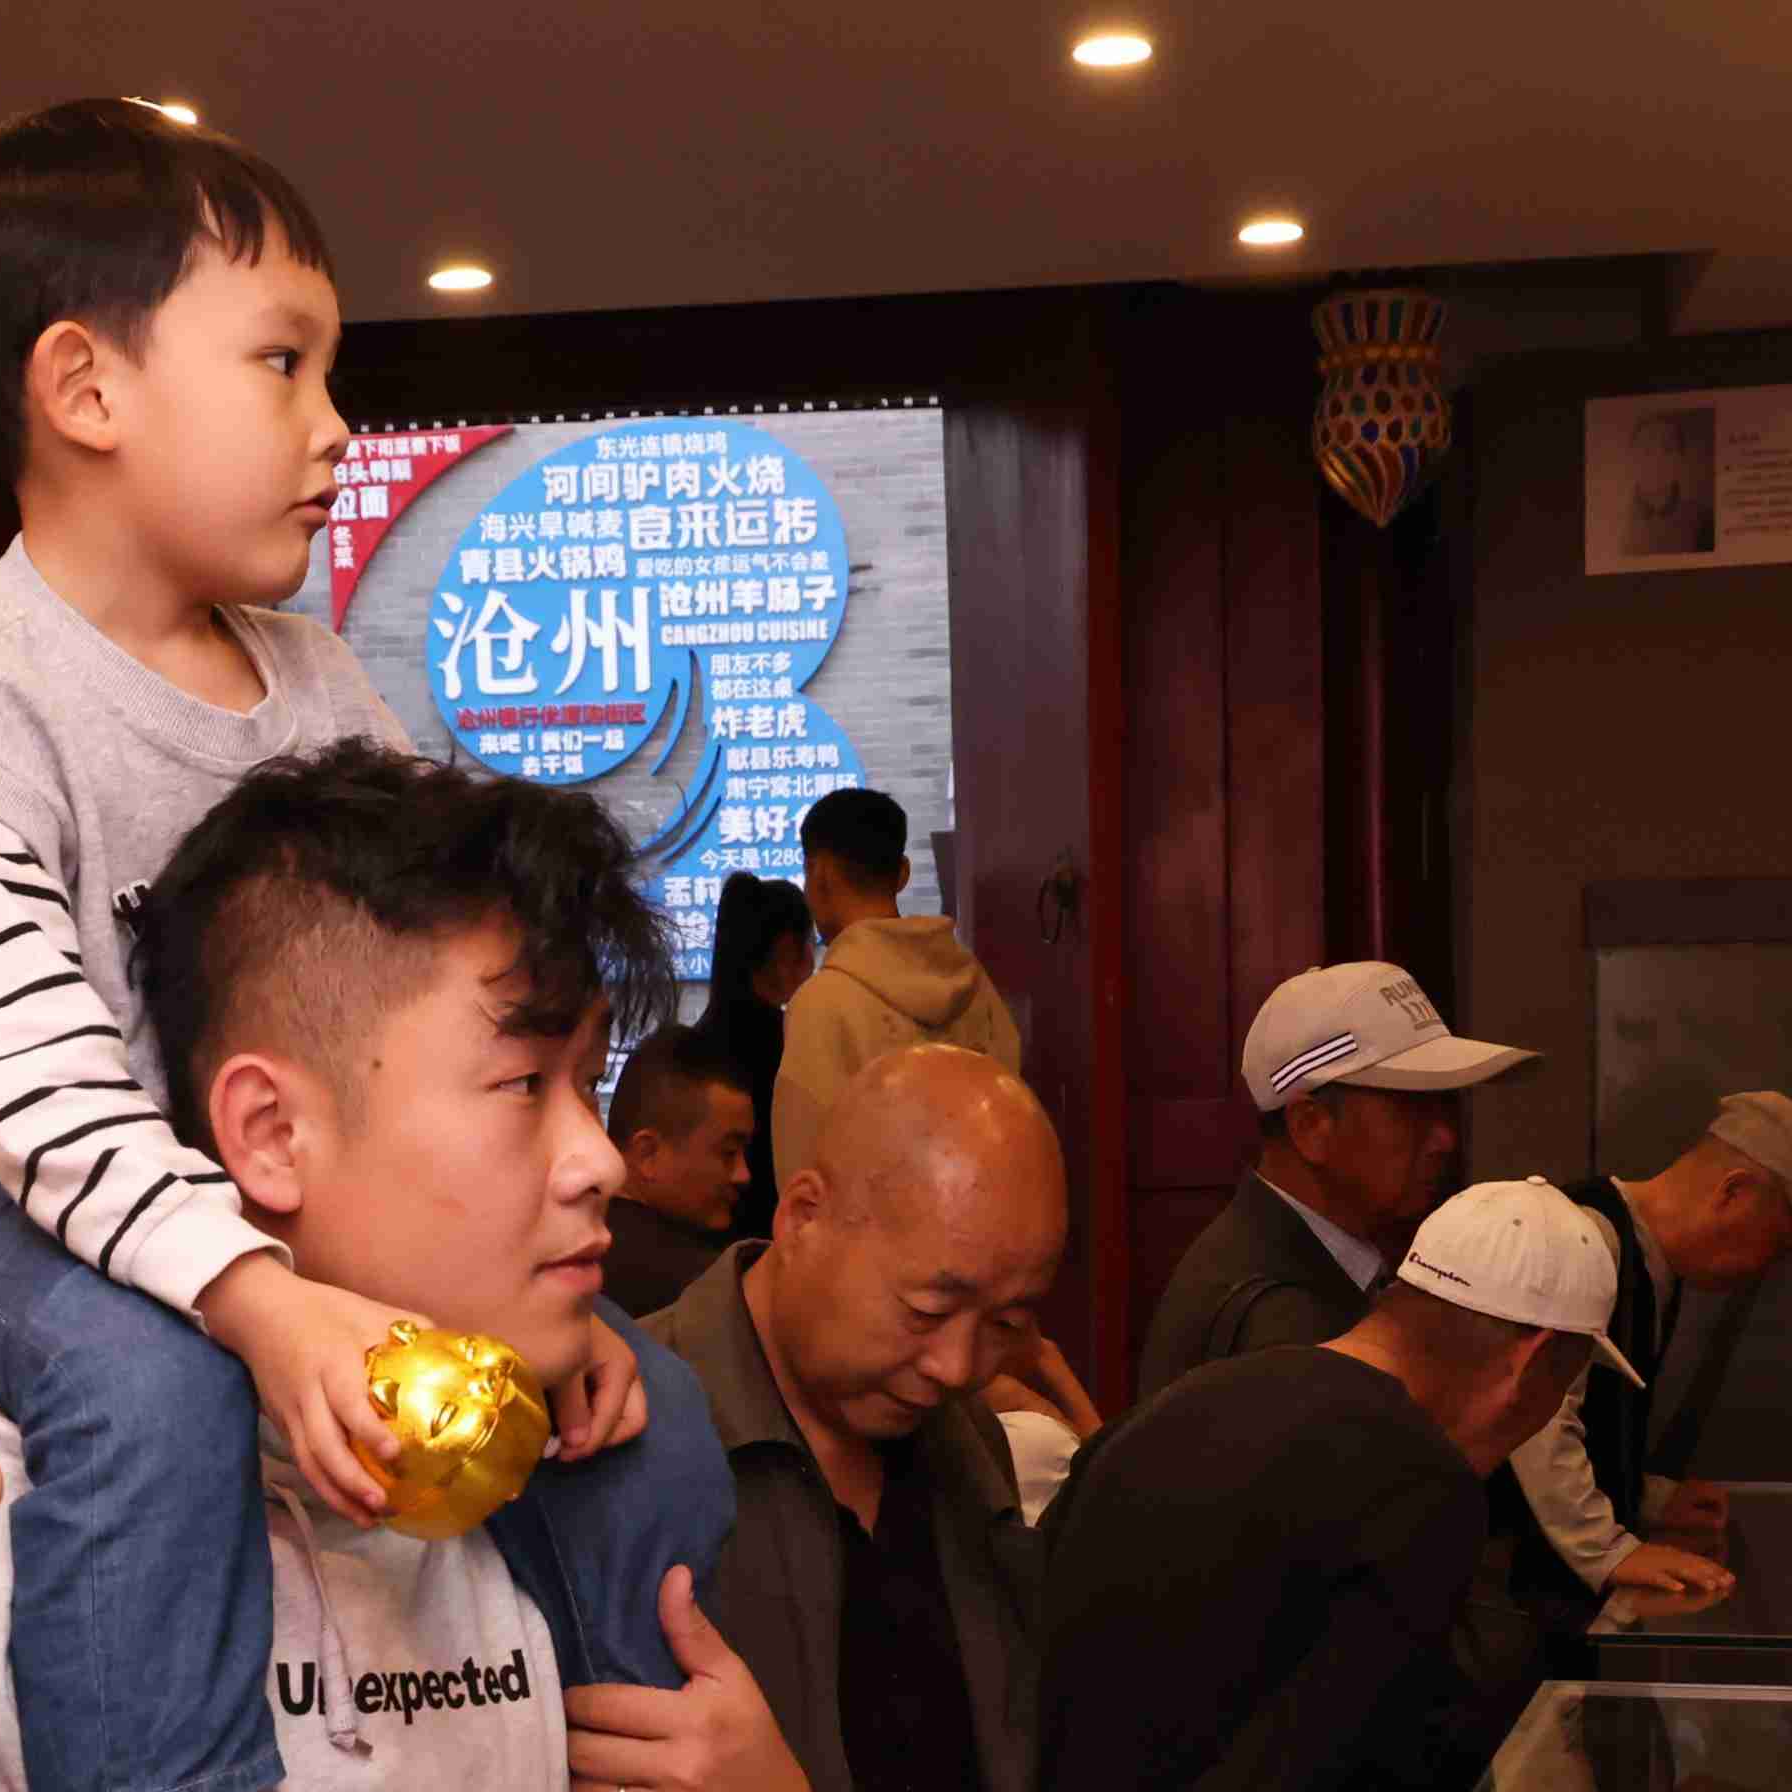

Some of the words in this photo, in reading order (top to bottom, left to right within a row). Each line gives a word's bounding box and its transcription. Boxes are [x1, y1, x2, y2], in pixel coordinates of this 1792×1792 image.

[543, 457, 784, 504] 河间驴肉火烧
[459, 543, 626, 583] 青县火锅鸡
[659, 576, 837, 617] 沧州羊肠子
[434, 586, 652, 699] 沧州
[662, 623, 753, 646] CANGZHOU
[757, 619, 828, 642] CUISINE
[710, 652, 791, 676] 朋友不多
[710, 679, 793, 699] 都在这桌
[712, 705, 807, 740] 炸老虎
[726, 746, 839, 771] 献县乐寿鸭
